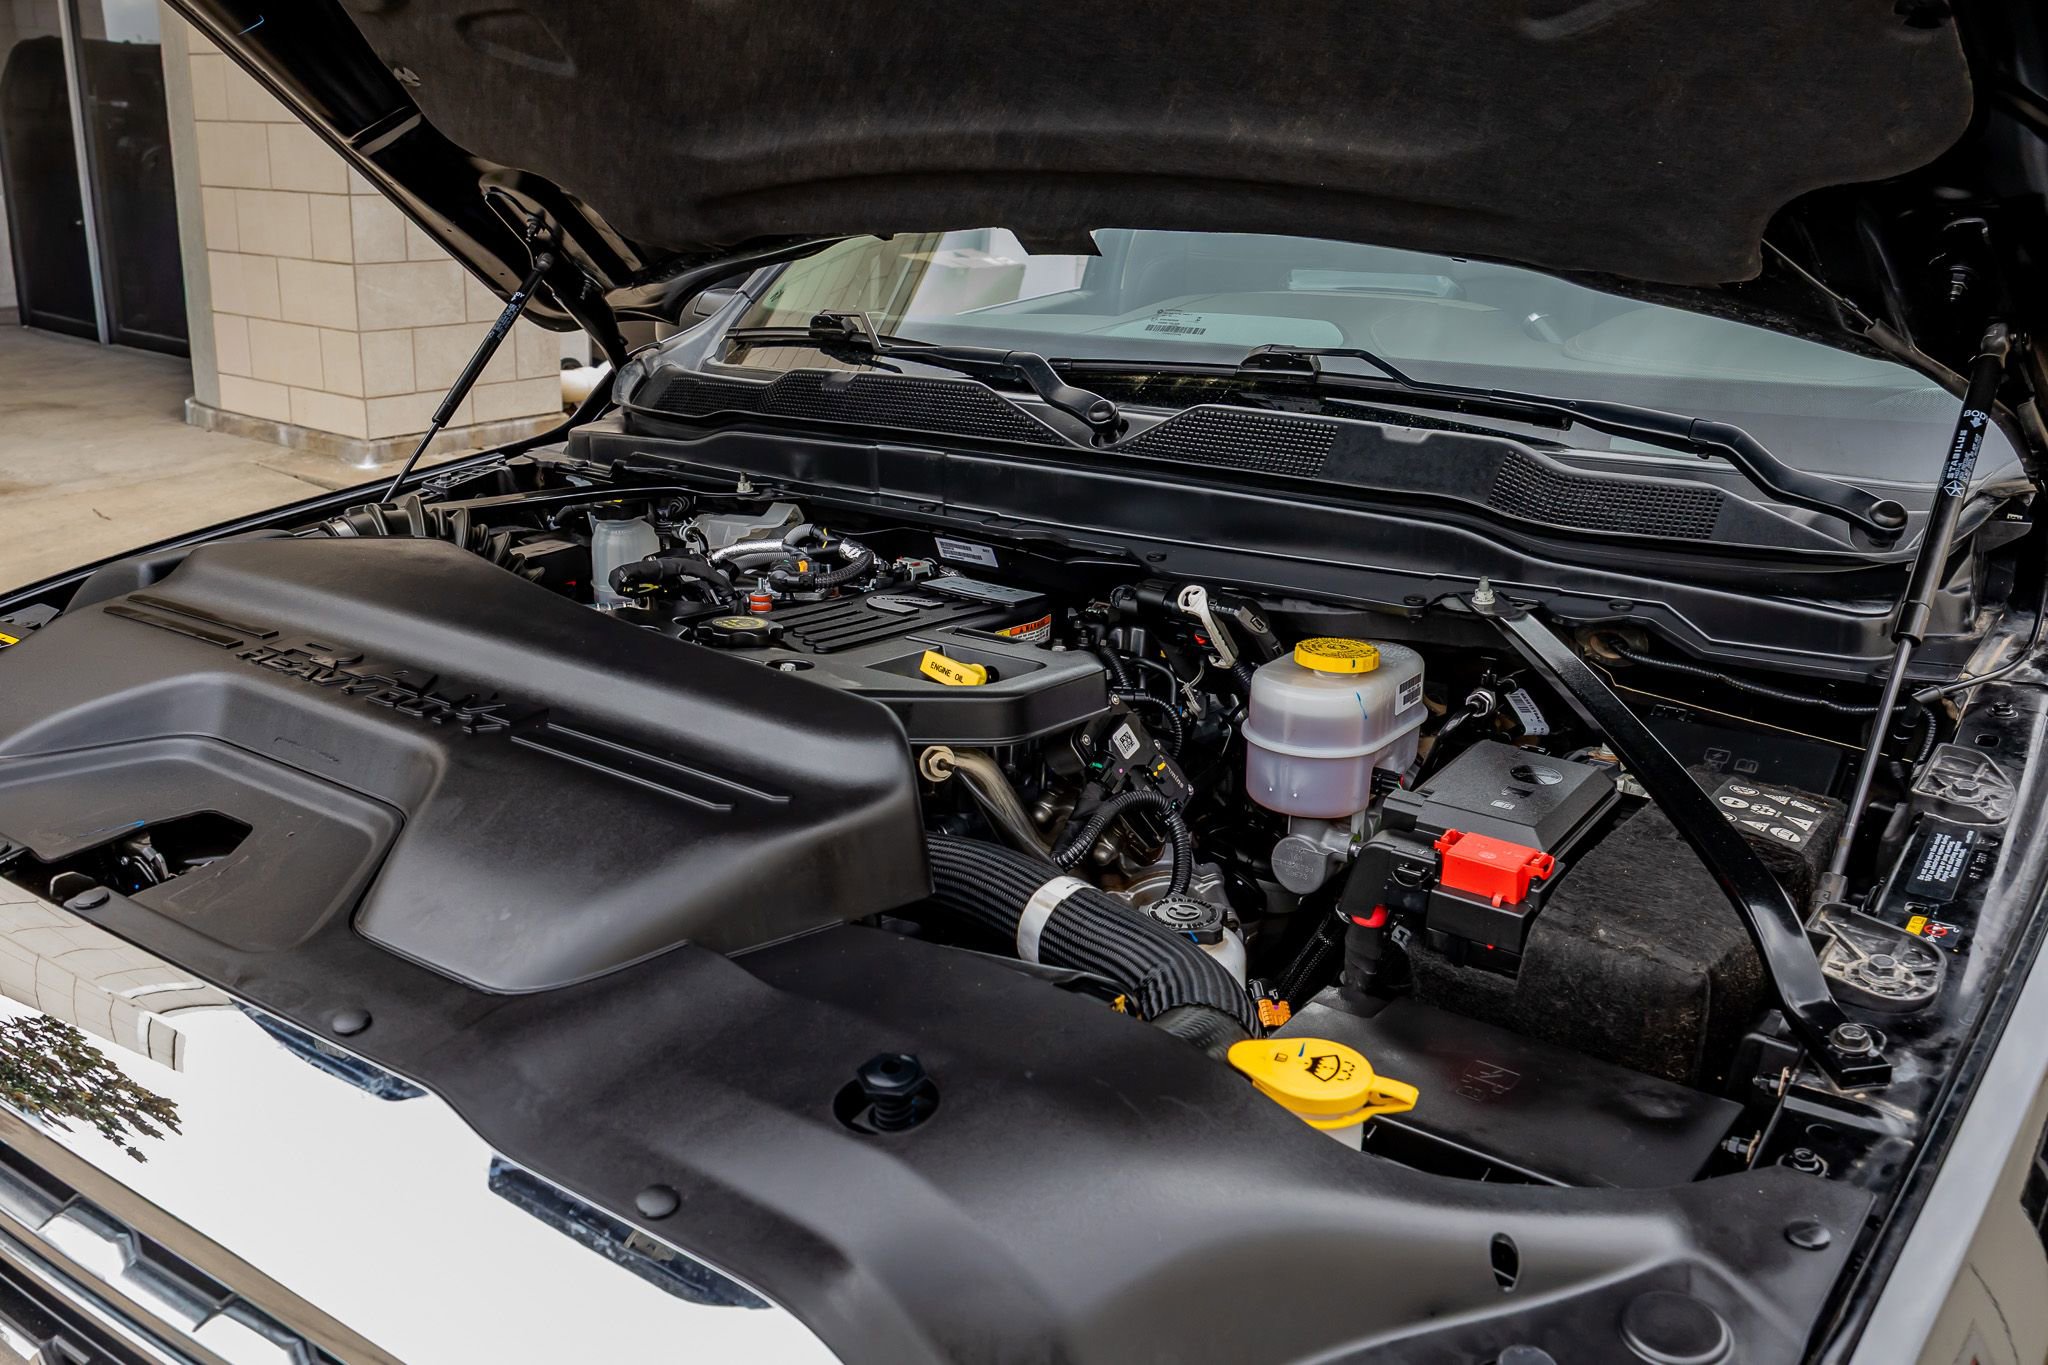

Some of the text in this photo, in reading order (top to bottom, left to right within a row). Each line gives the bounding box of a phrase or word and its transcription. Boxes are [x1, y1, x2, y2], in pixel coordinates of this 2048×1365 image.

[1947, 429, 1968, 479] STABILUS
[235, 648, 505, 734] HEAVY DUTY
[930, 661, 964, 684] ENGINE OIL
